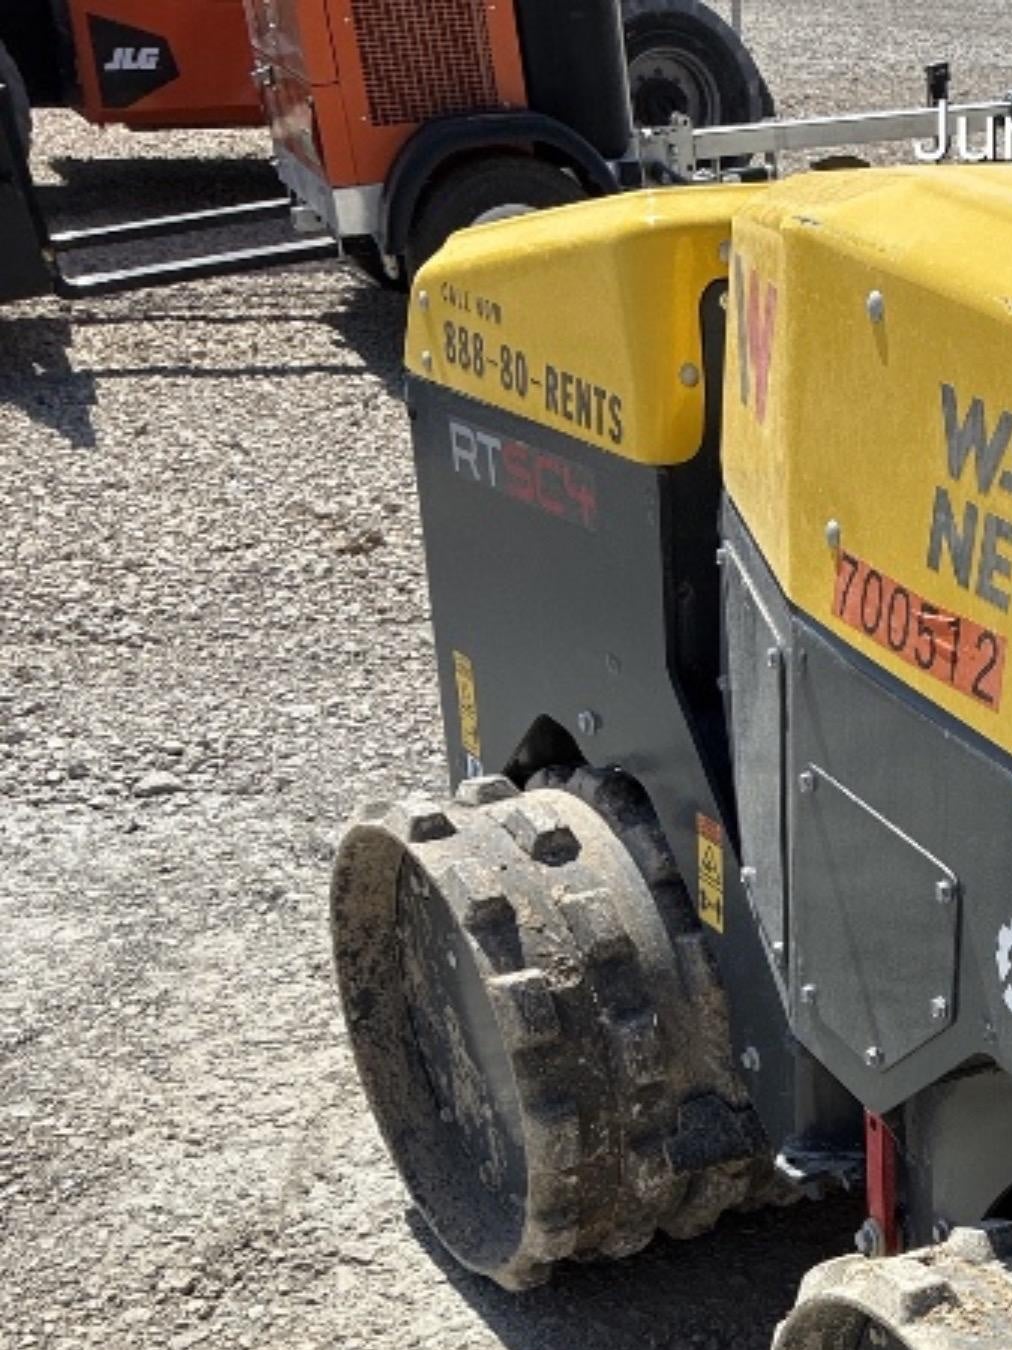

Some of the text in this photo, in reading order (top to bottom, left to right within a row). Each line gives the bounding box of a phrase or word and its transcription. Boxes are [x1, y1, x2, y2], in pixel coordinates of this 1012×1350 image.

[103, 47, 160, 71] JLG
[444, 319, 624, 445] 888-80-RENTS
[838, 552, 998, 704] 700512
